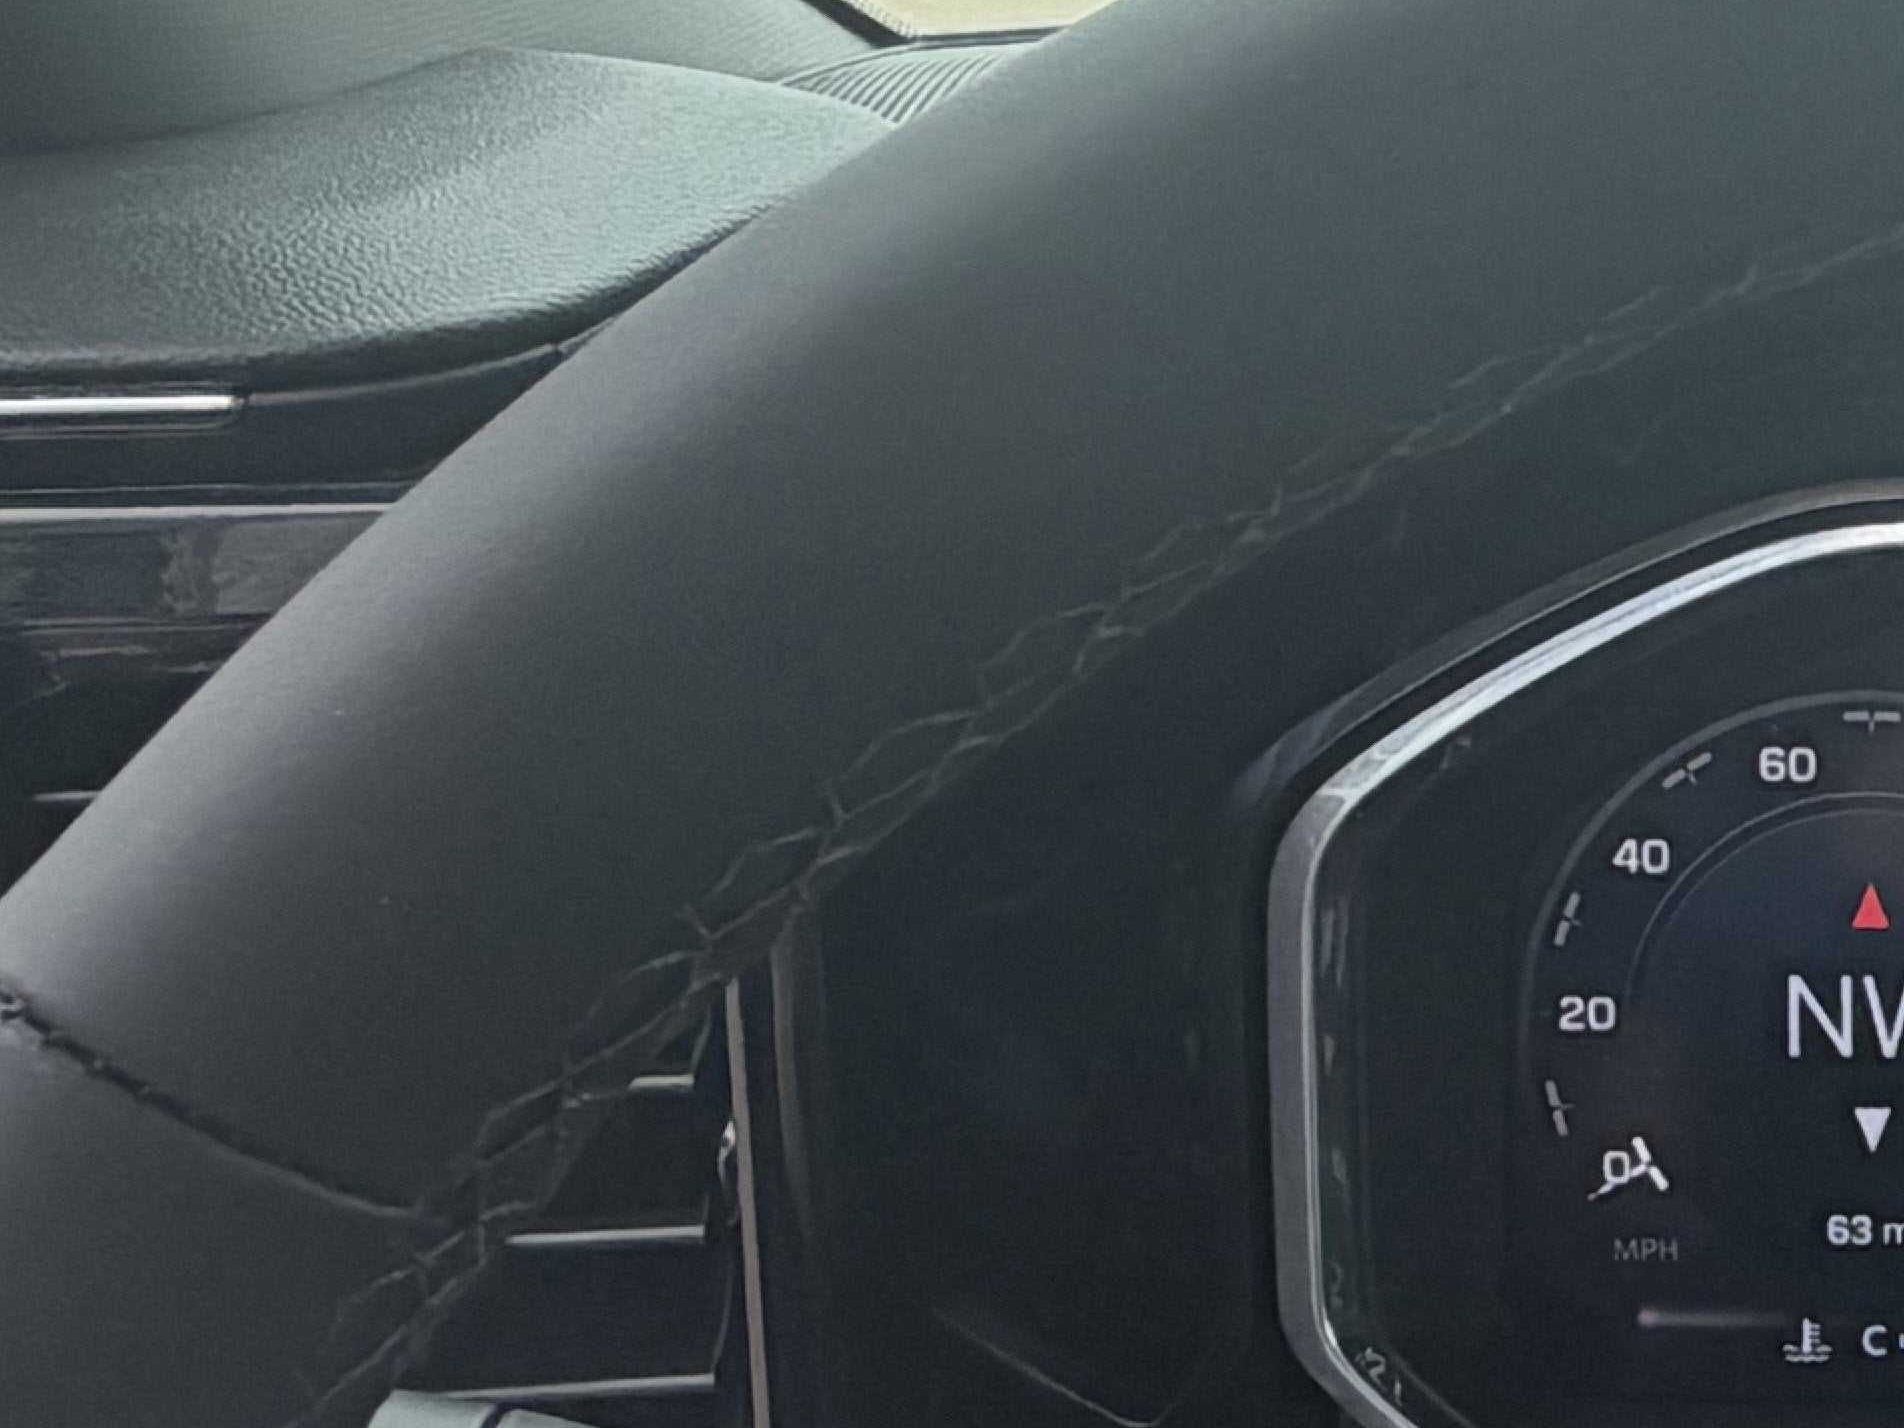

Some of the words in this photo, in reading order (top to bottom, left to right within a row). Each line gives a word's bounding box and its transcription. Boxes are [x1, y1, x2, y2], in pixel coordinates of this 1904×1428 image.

[1760, 747, 1815, 781] 60
[1613, 839, 1669, 873] 40
[1559, 997, 1615, 1031] 20
[1603, 1150, 1629, 1183] 0
[1827, 1215, 1872, 1245] 63
[1615, 1239, 1677, 1261] MPH
[1863, 1325, 1887, 1356] C
